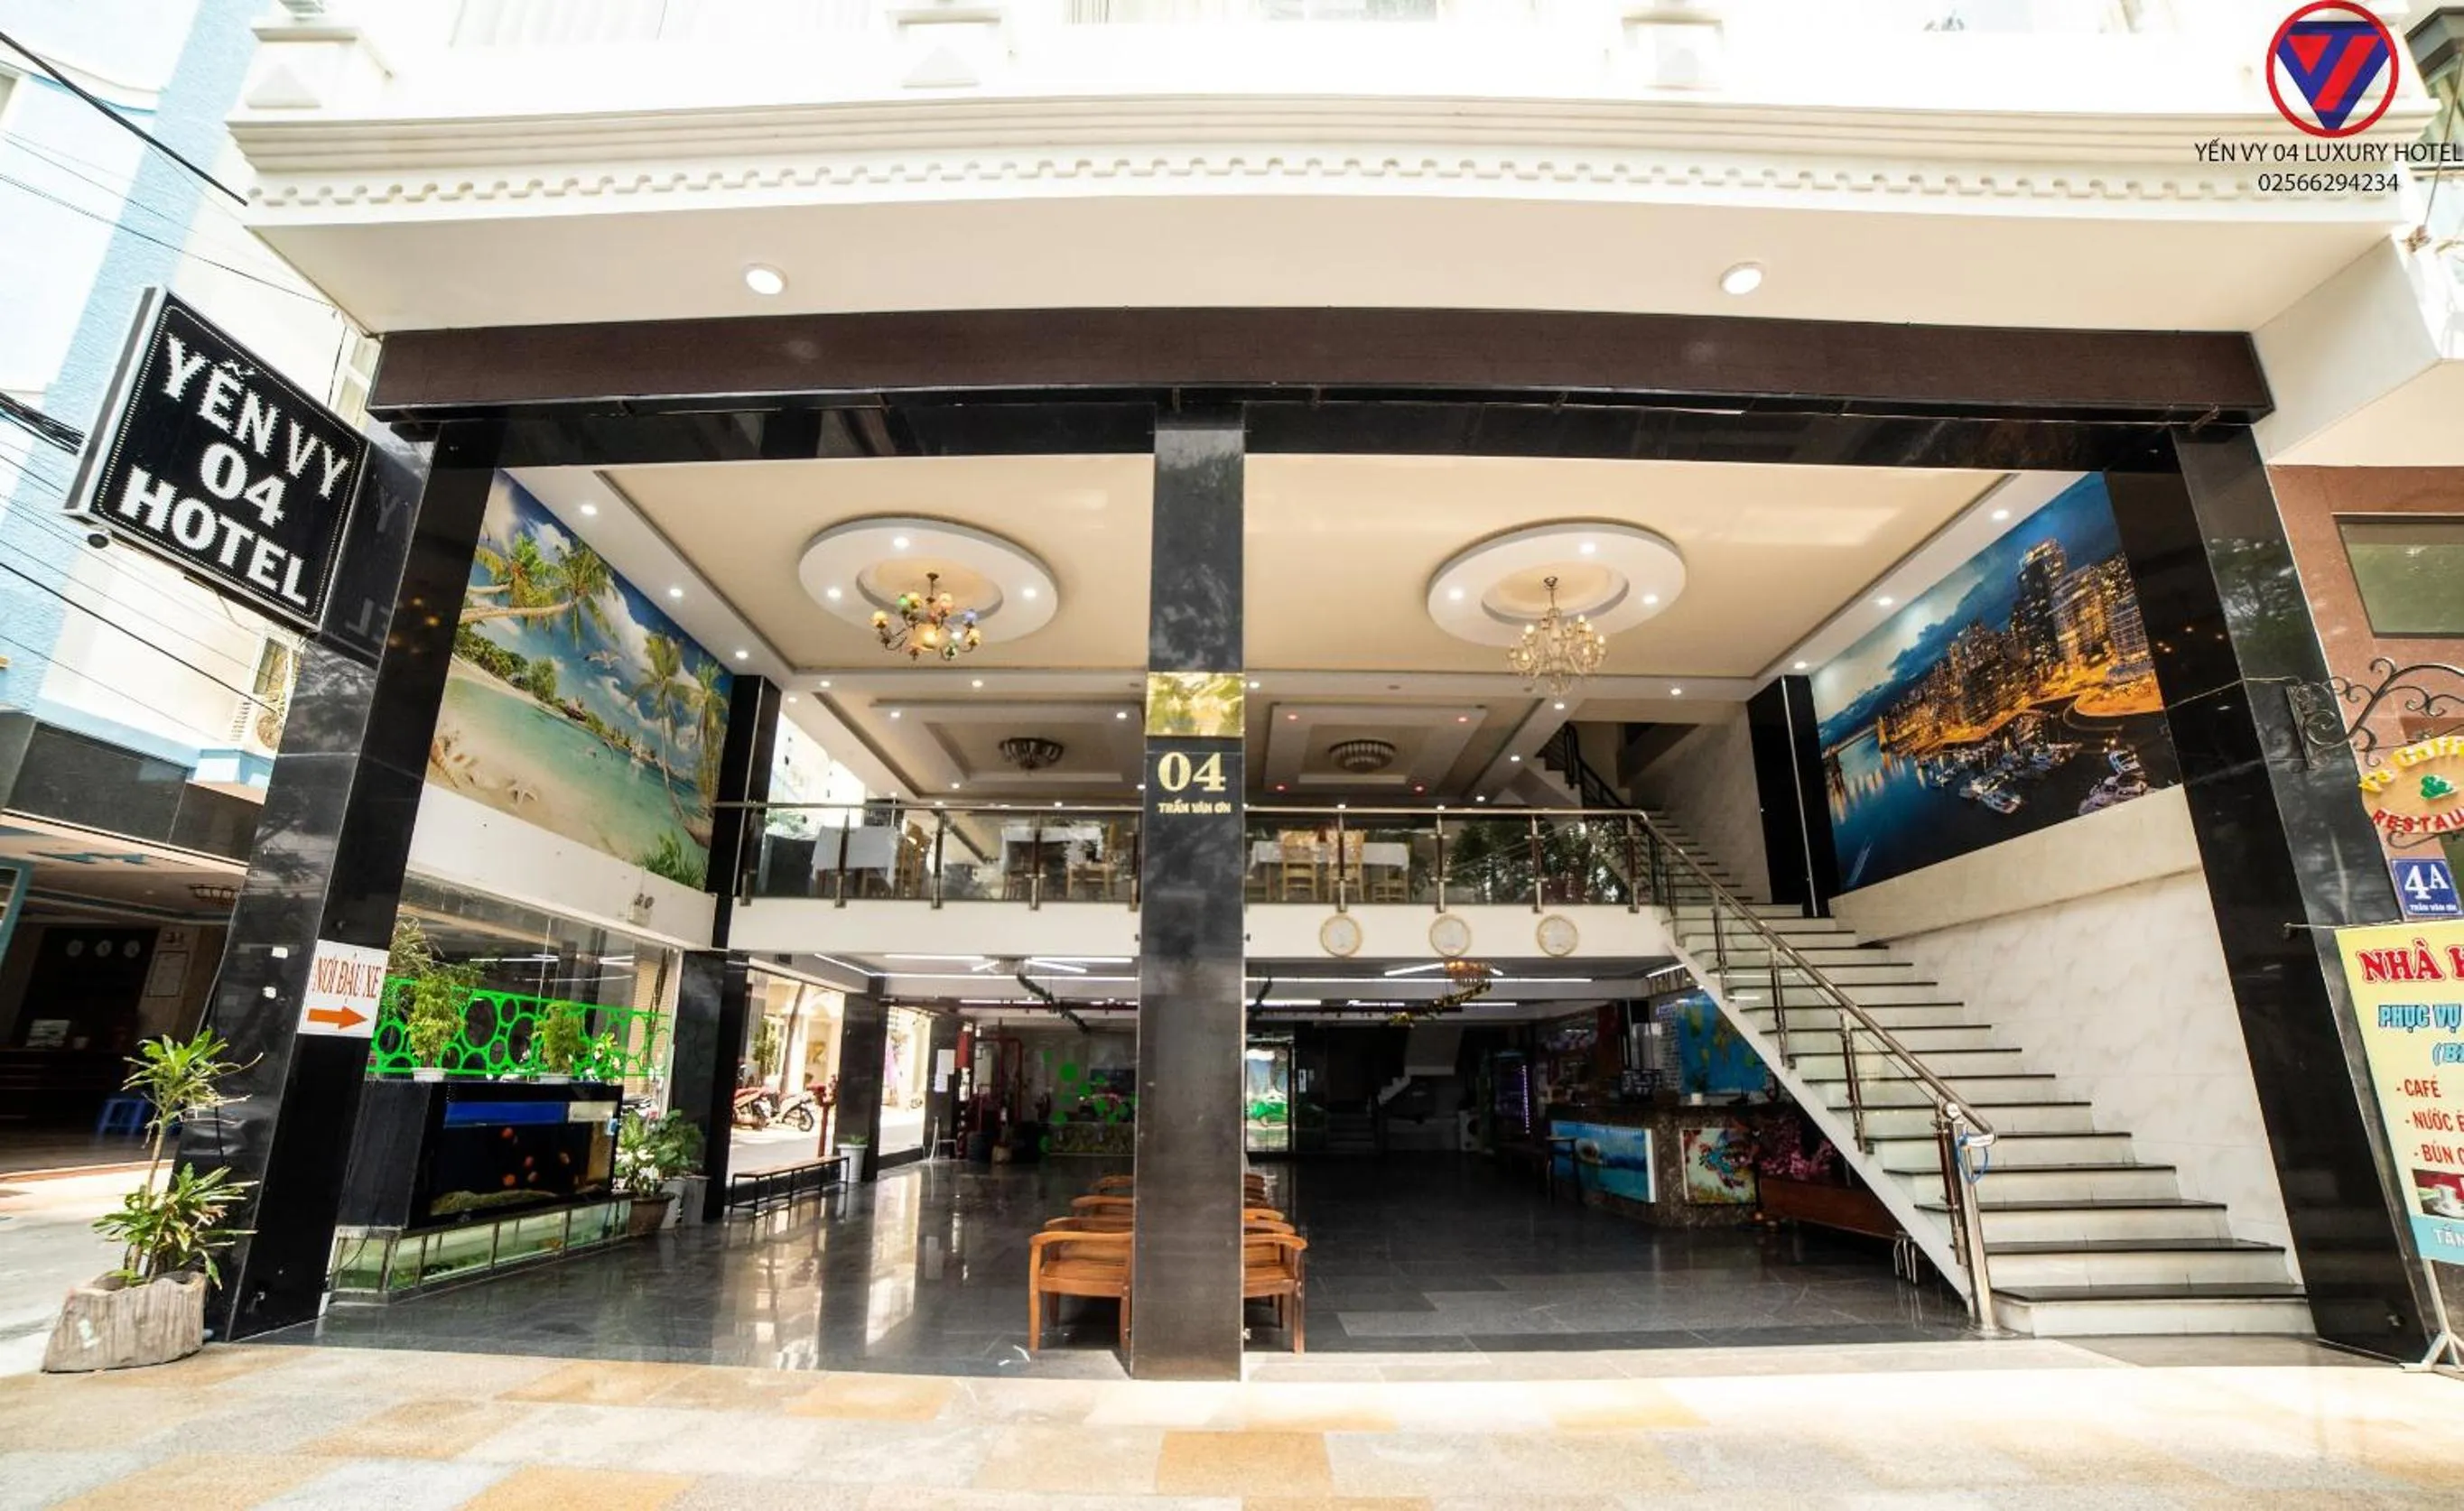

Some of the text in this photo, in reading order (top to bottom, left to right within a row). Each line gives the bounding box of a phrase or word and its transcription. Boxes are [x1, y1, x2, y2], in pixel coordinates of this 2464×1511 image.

[162, 332, 349, 499] YẾN VY
[200, 442, 287, 527] 04
[117, 464, 308, 607] HOTEL
[1158, 752, 1226, 792] 04
[2404, 864, 2450, 899] 4A
[2357, 939, 2445, 981] NHÀ
[2378, 1003, 2461, 1034] PHỤC VỤ
[2404, 1075, 2441, 1098] CAFÉ
[2421, 1140, 2454, 1164] BÚN
